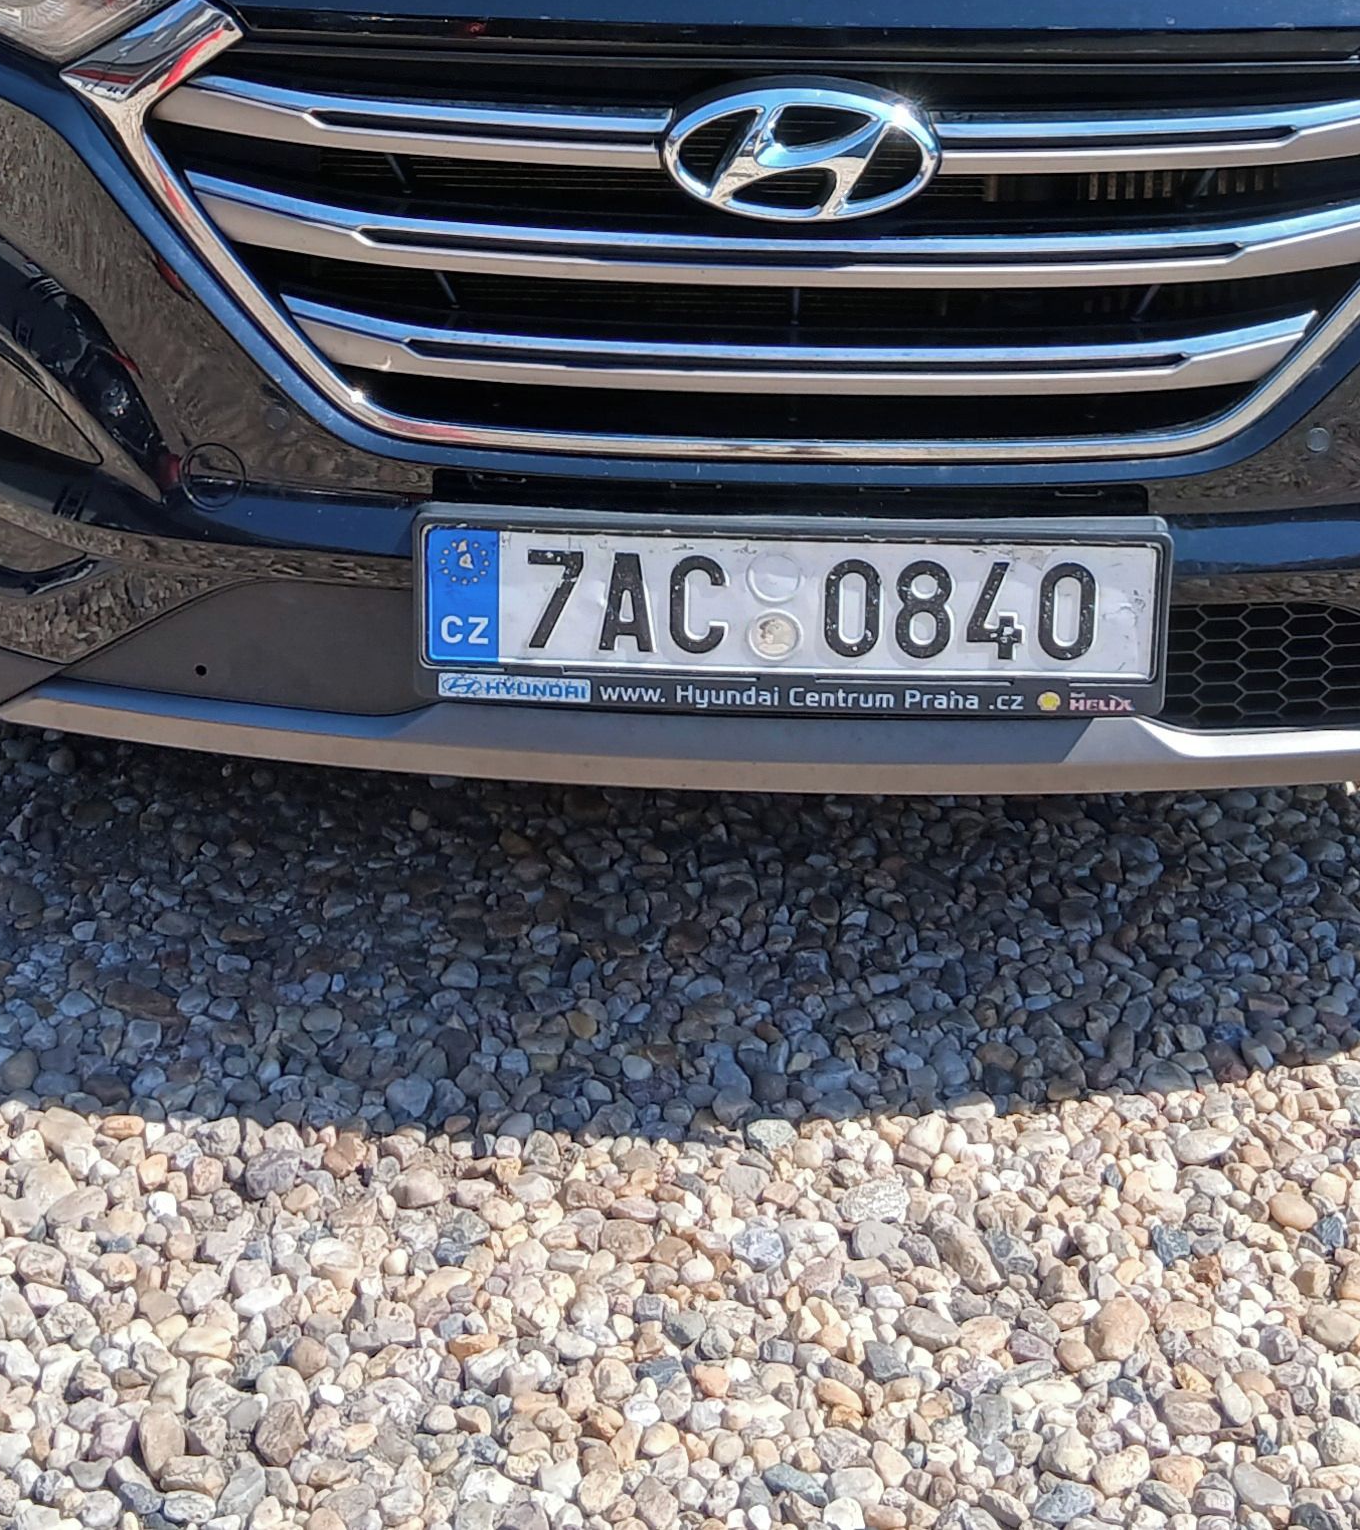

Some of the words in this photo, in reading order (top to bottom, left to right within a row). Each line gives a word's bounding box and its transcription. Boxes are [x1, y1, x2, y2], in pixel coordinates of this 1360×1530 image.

[527, 548, 728, 655] 7AC
[823, 558, 1097, 661] 0840
[440, 614, 490, 645] CZ
[484, 681, 588, 700] HYUNDAI
[598, 683, 666, 703] www.
[676, 684, 780, 708] Hyundai
[788, 687, 894, 708] Centrum
[904, 689, 979, 710] Praha
[988, 692, 1024, 711] .cz
[1068, 695, 1136, 711] HELIX
